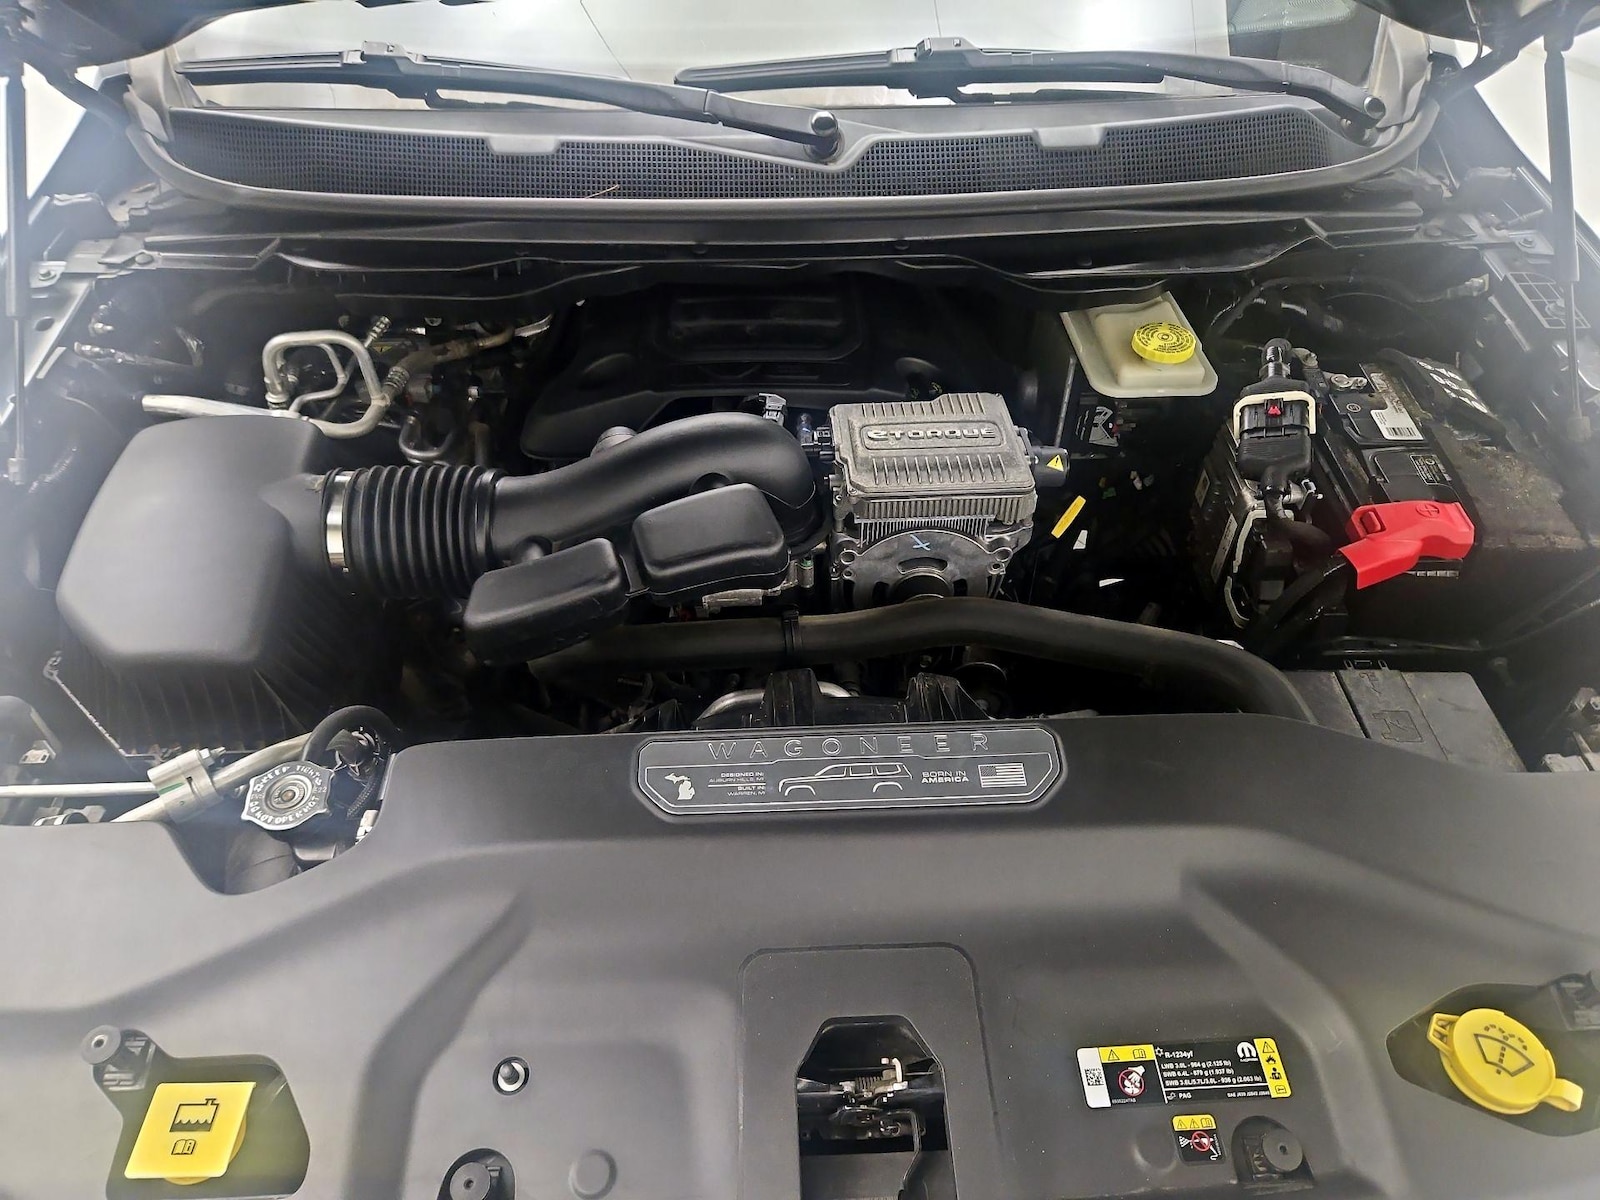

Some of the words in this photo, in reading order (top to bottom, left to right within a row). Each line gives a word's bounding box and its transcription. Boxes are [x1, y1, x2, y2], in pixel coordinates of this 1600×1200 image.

[867, 428, 996, 441] eTORQUE
[708, 733, 988, 760] WAGONEER
[922, 770, 953, 778] BORN
[1164, 1050, 1194, 1059] R-1234yf
